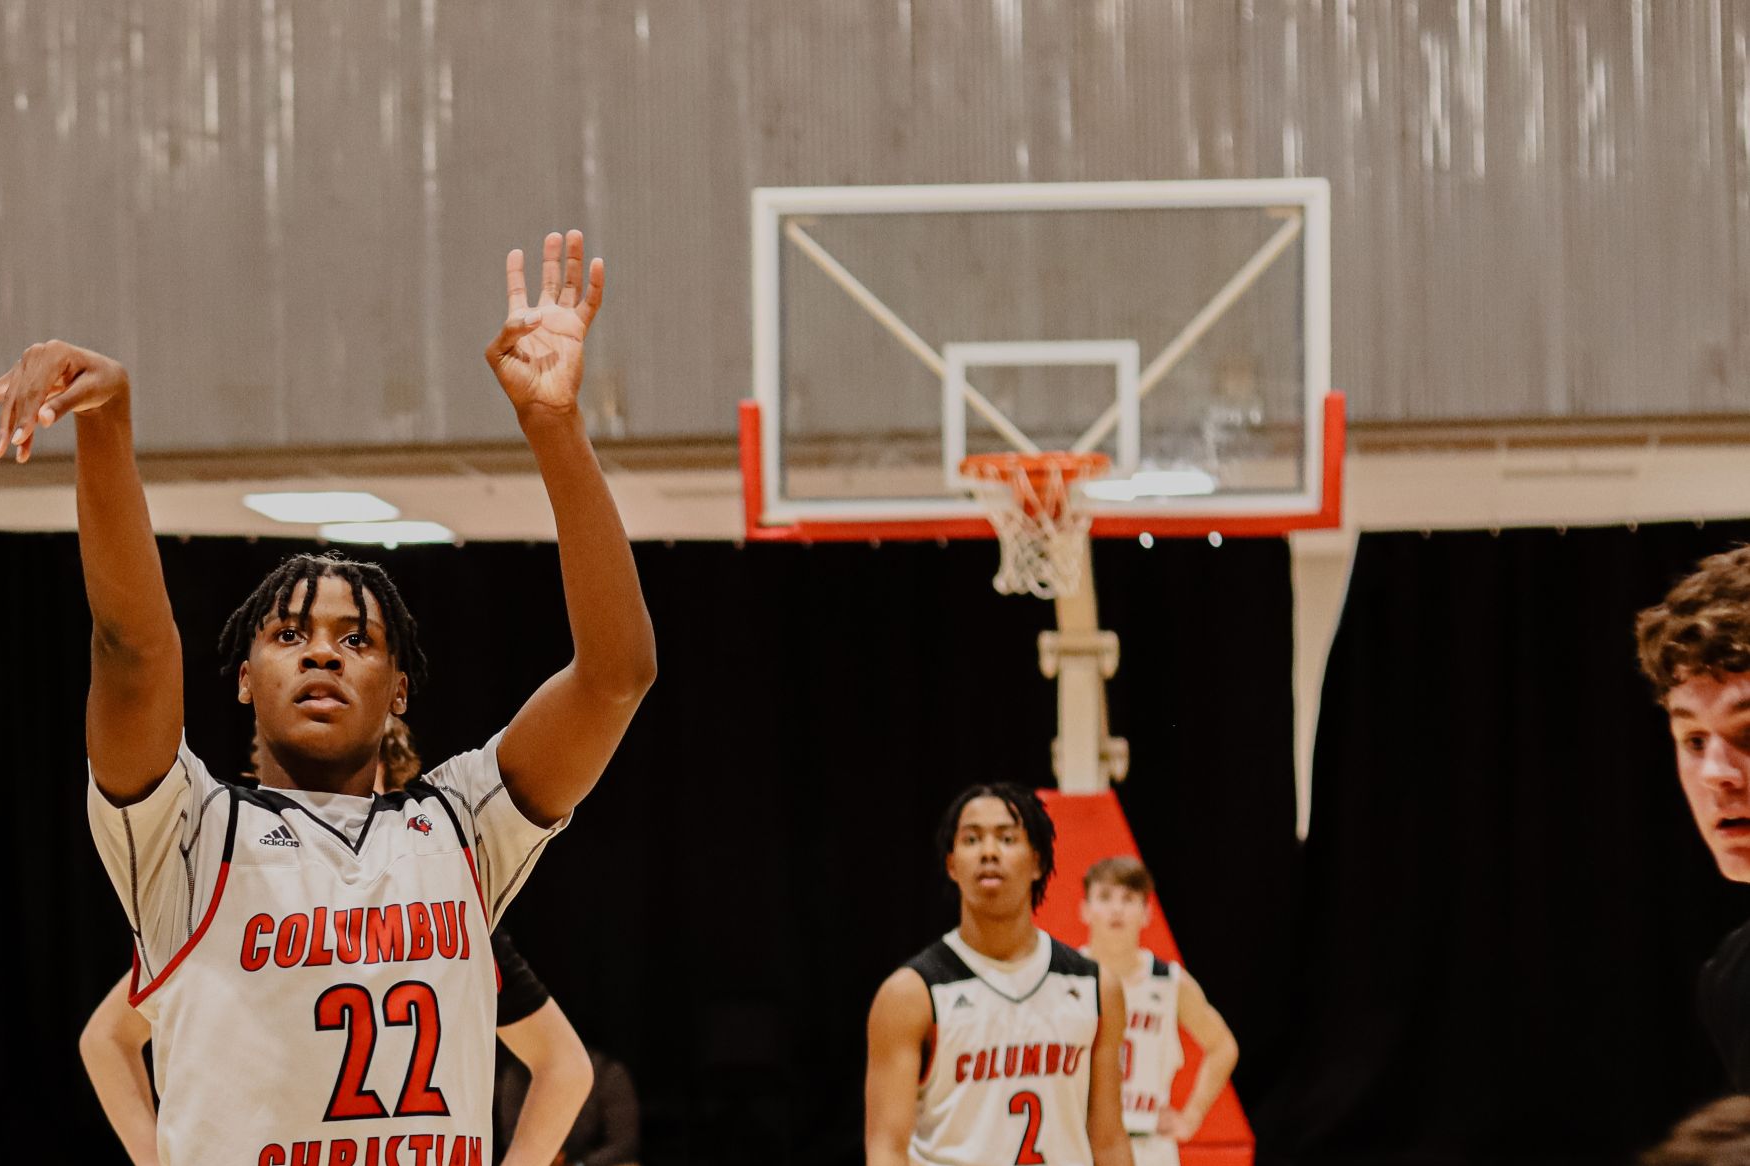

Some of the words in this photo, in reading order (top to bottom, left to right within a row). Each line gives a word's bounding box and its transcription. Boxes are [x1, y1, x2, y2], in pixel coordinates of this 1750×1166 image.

[259, 838, 299, 848] adidas
[314, 980, 451, 1122] 22
[1008, 1090, 1046, 1166] 2
